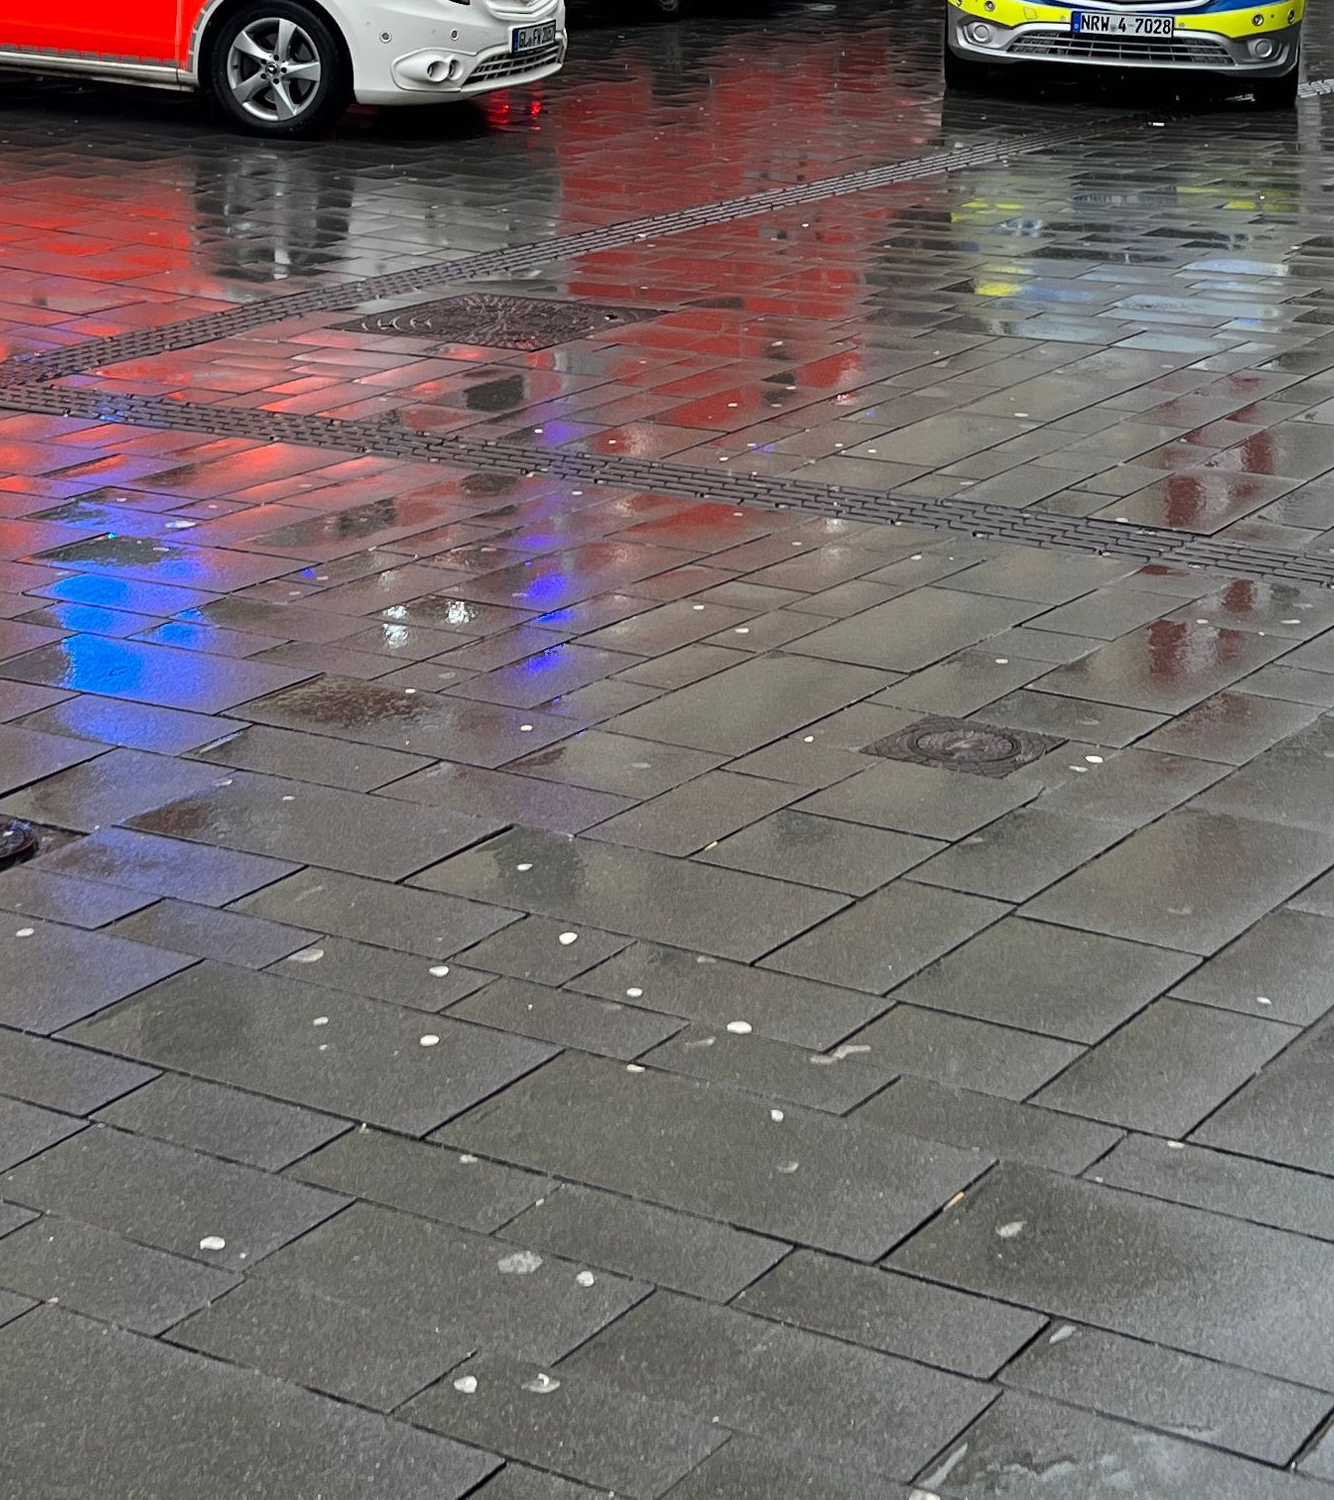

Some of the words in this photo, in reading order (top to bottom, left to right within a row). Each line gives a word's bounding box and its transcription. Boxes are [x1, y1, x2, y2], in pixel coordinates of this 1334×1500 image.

[1081, 13, 1110, 32] NRW
[1118, 16, 1127, 33] 4
[1135, 17, 1172, 35] 7028
